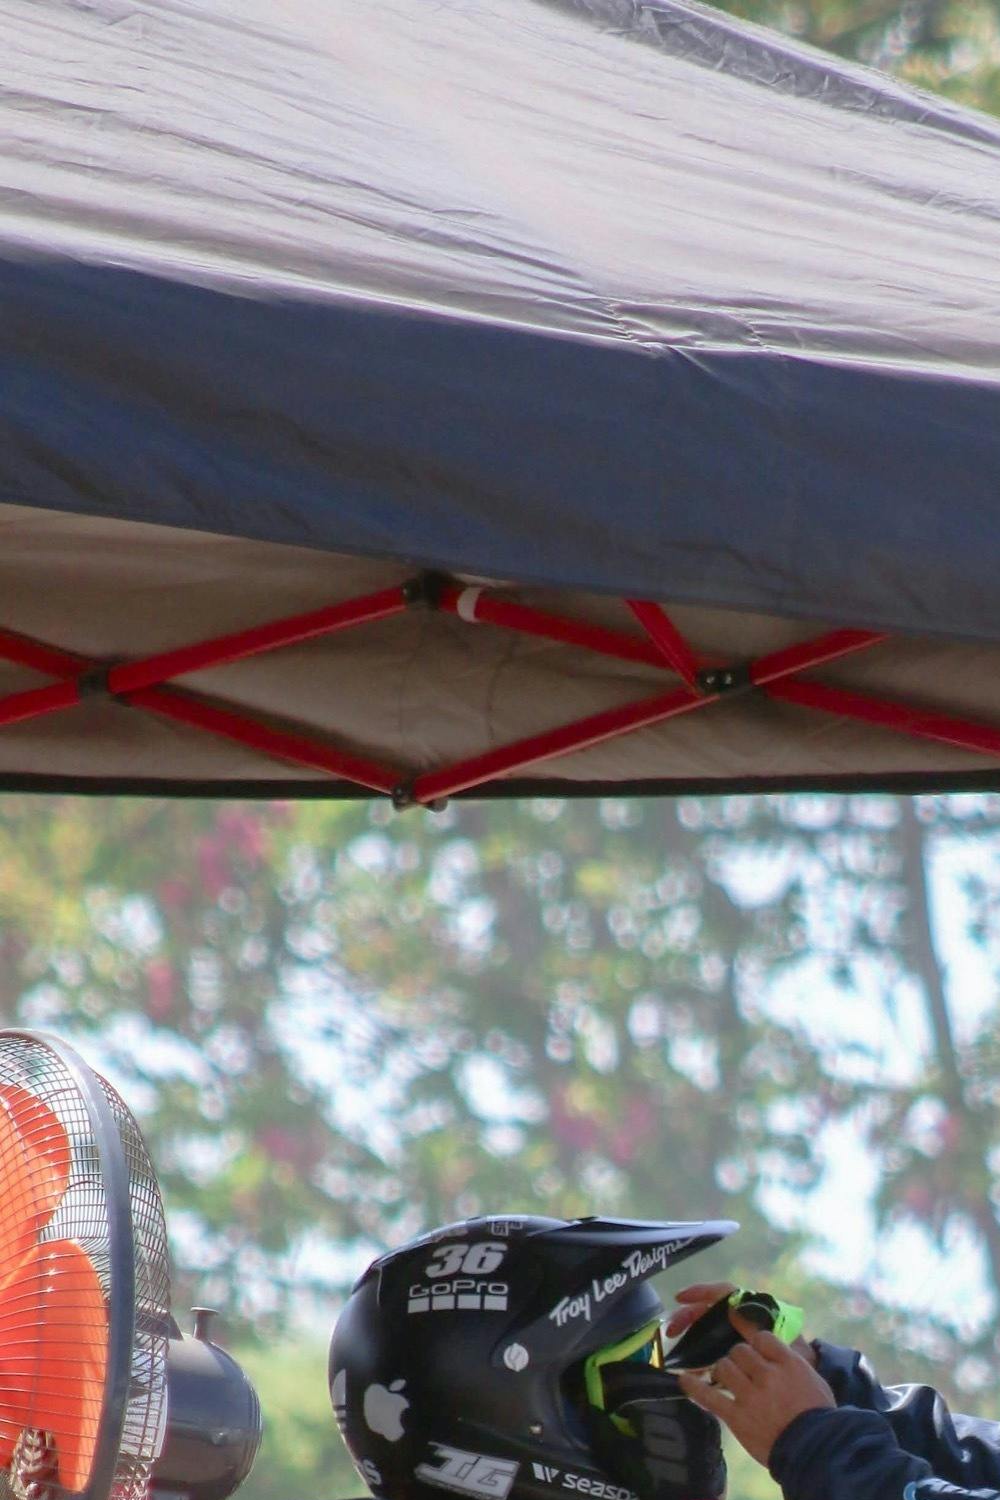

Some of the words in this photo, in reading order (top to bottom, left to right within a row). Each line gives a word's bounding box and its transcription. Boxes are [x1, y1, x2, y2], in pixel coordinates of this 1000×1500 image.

[425, 1241, 508, 1278] 36
[408, 1279, 509, 1299] GoPro
[549, 1293, 592, 1327] Troy
[592, 1273, 627, 1302] Lee
